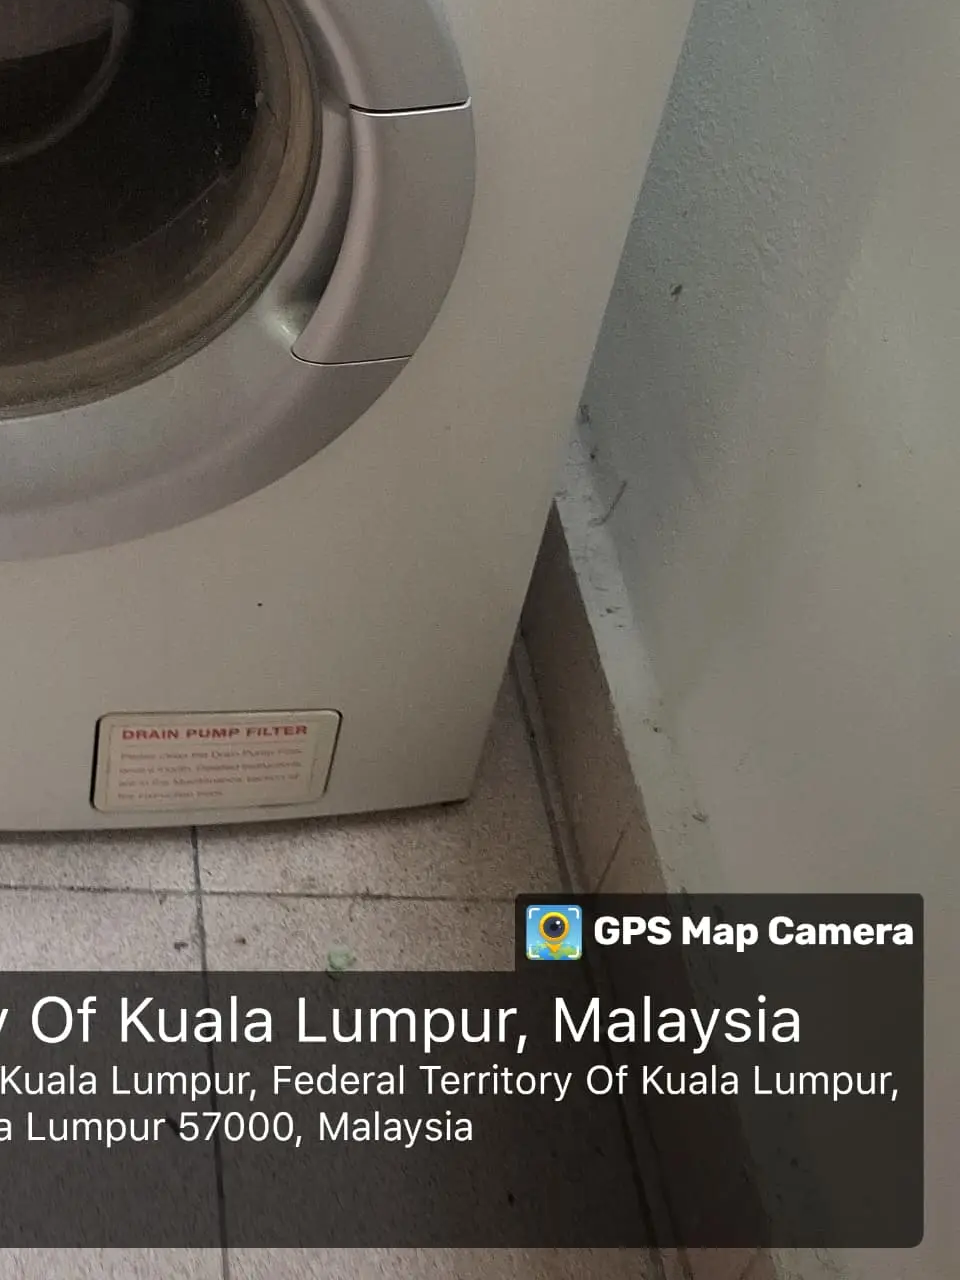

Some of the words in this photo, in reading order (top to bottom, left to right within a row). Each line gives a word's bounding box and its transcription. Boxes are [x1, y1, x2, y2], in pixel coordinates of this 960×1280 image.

[122, 727, 180, 740] DRAIN
[186, 728, 242, 738] PUMP
[246, 725, 308, 737] FILTER
